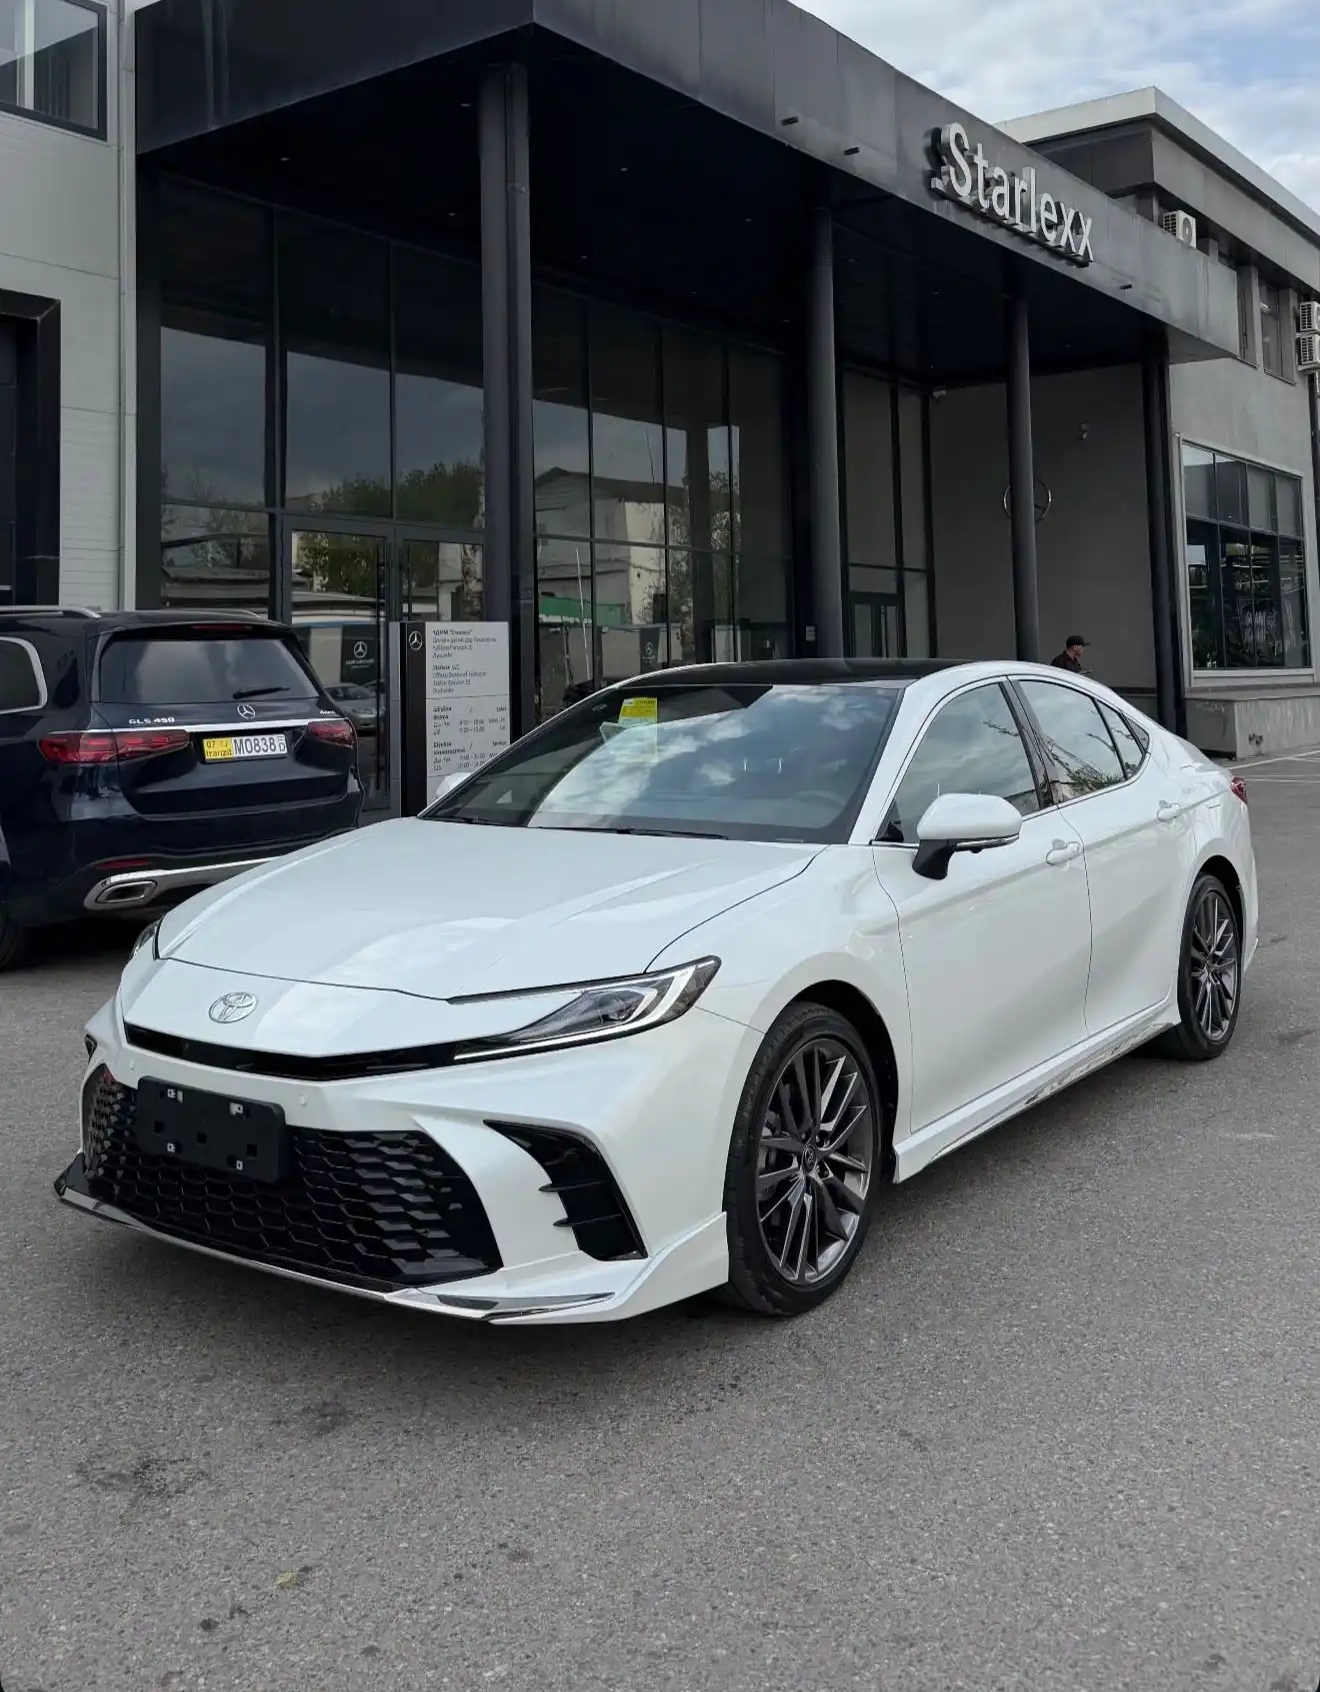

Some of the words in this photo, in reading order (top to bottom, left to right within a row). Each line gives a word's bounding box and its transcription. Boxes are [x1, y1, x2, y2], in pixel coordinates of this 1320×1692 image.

[935, 122, 1095, 262] Starlexx
[153, 716, 175, 724] 450
[205, 748, 232, 758] tranzit
